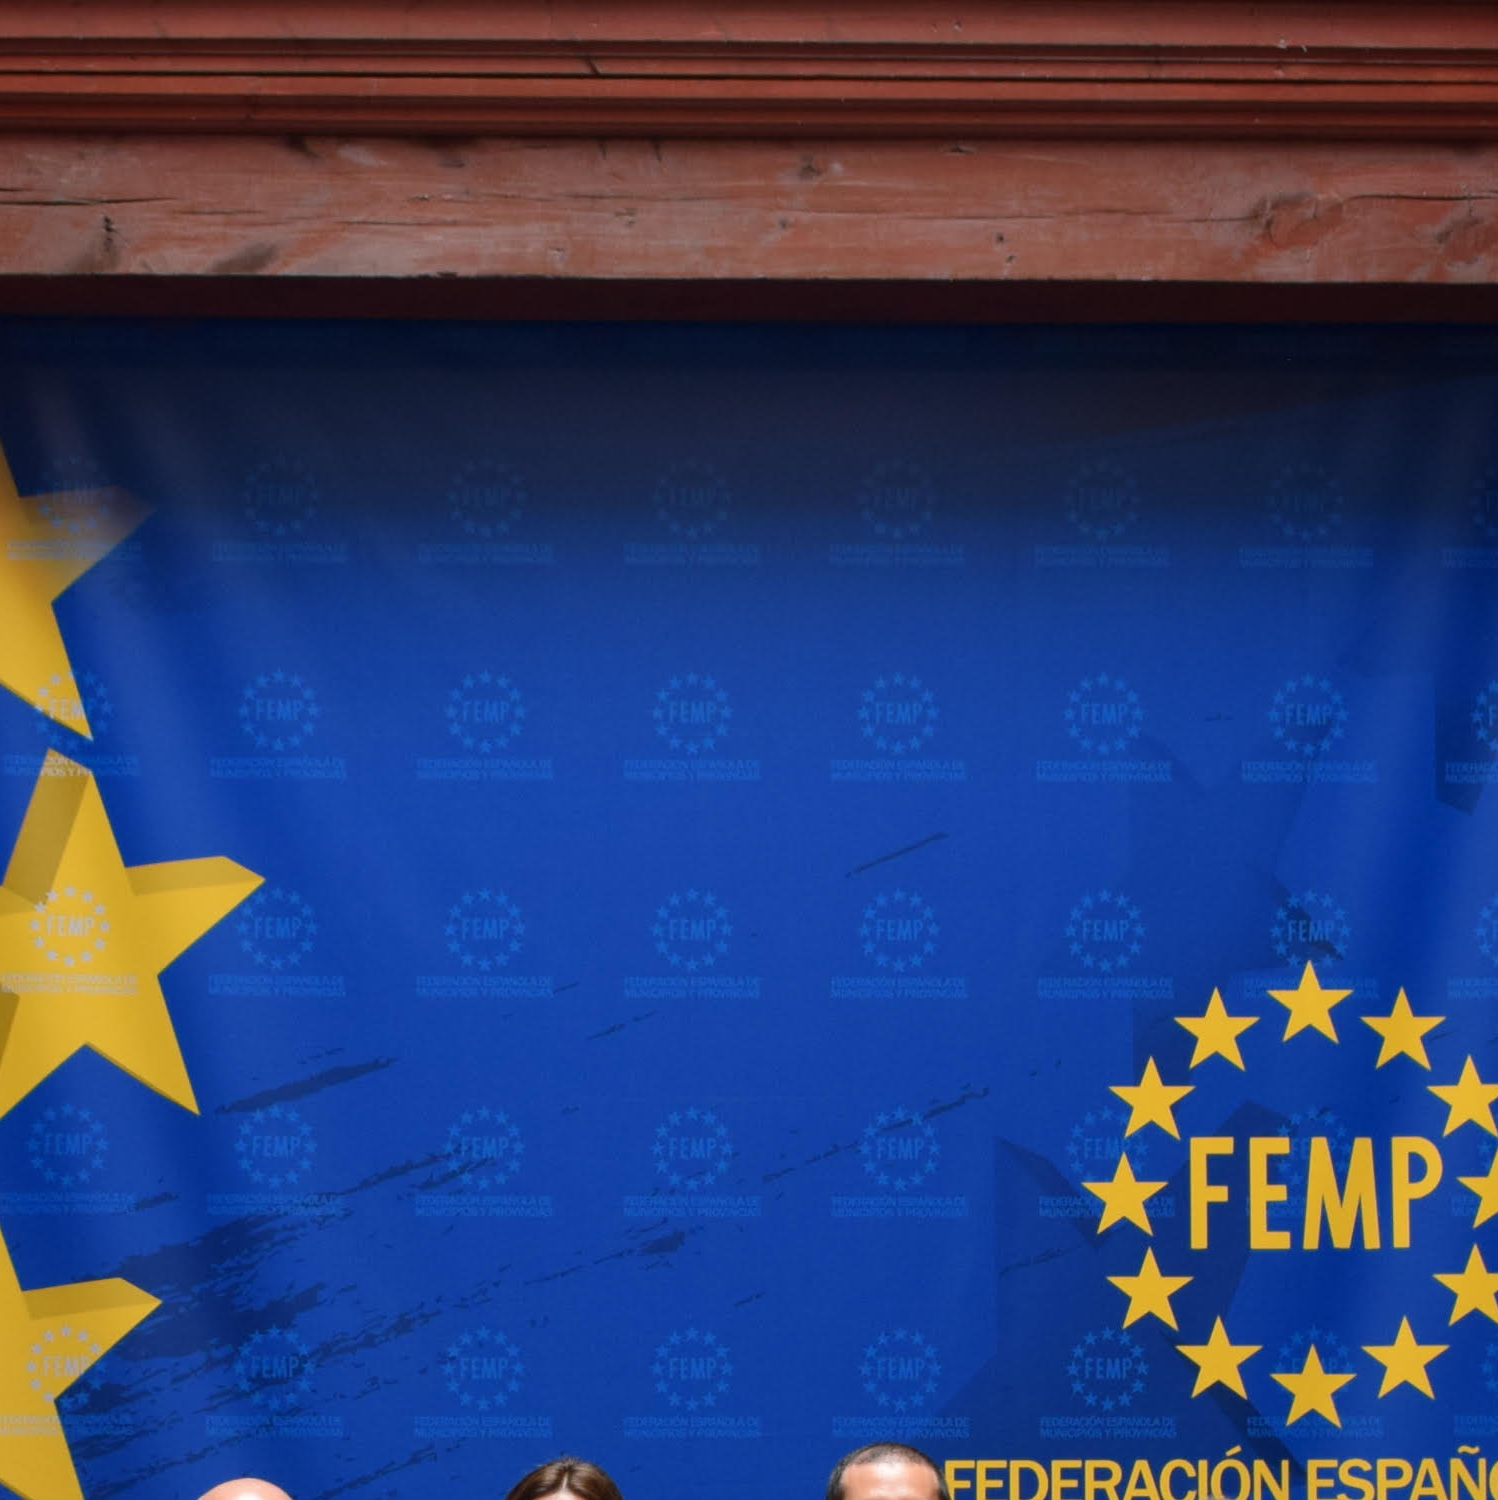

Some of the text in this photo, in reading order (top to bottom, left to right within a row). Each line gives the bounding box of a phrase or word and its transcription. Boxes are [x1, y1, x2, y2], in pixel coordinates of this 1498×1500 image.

[256, 699, 304, 722] FEMP
[462, 700, 510, 723] FEMP
[669, 701, 717, 724] FEMP
[875, 701, 923, 724] FEMP
[1081, 702, 1129, 725] FEMP
[1285, 703, 1333, 726] FEMP
[47, 915, 95, 938] FEMP
[254, 916, 302, 939] FEMP
[462, 917, 510, 940] FEMP
[669, 918, 717, 941] FEMP
[876, 918, 924, 941] FEMP
[1082, 919, 1130, 942] FEMP
[1287, 919, 1335, 942] FEMP
[44, 1133, 92, 1156] FEMP
[252, 1135, 300, 1158] FEMP
[461, 1136, 509, 1159] FEMP
[669, 1137, 717, 1160] FEMP
[877, 1137, 925, 1160] FEMP
[1189, 1136, 1444, 1250] FEMP
[251, 1356, 299, 1379] FEMP
[460, 1357, 508, 1380] FEMP
[669, 1357, 717, 1380] FEMP
[877, 1357, 925, 1380] FEMP
[1085, 1357, 1133, 1380] FEMP
